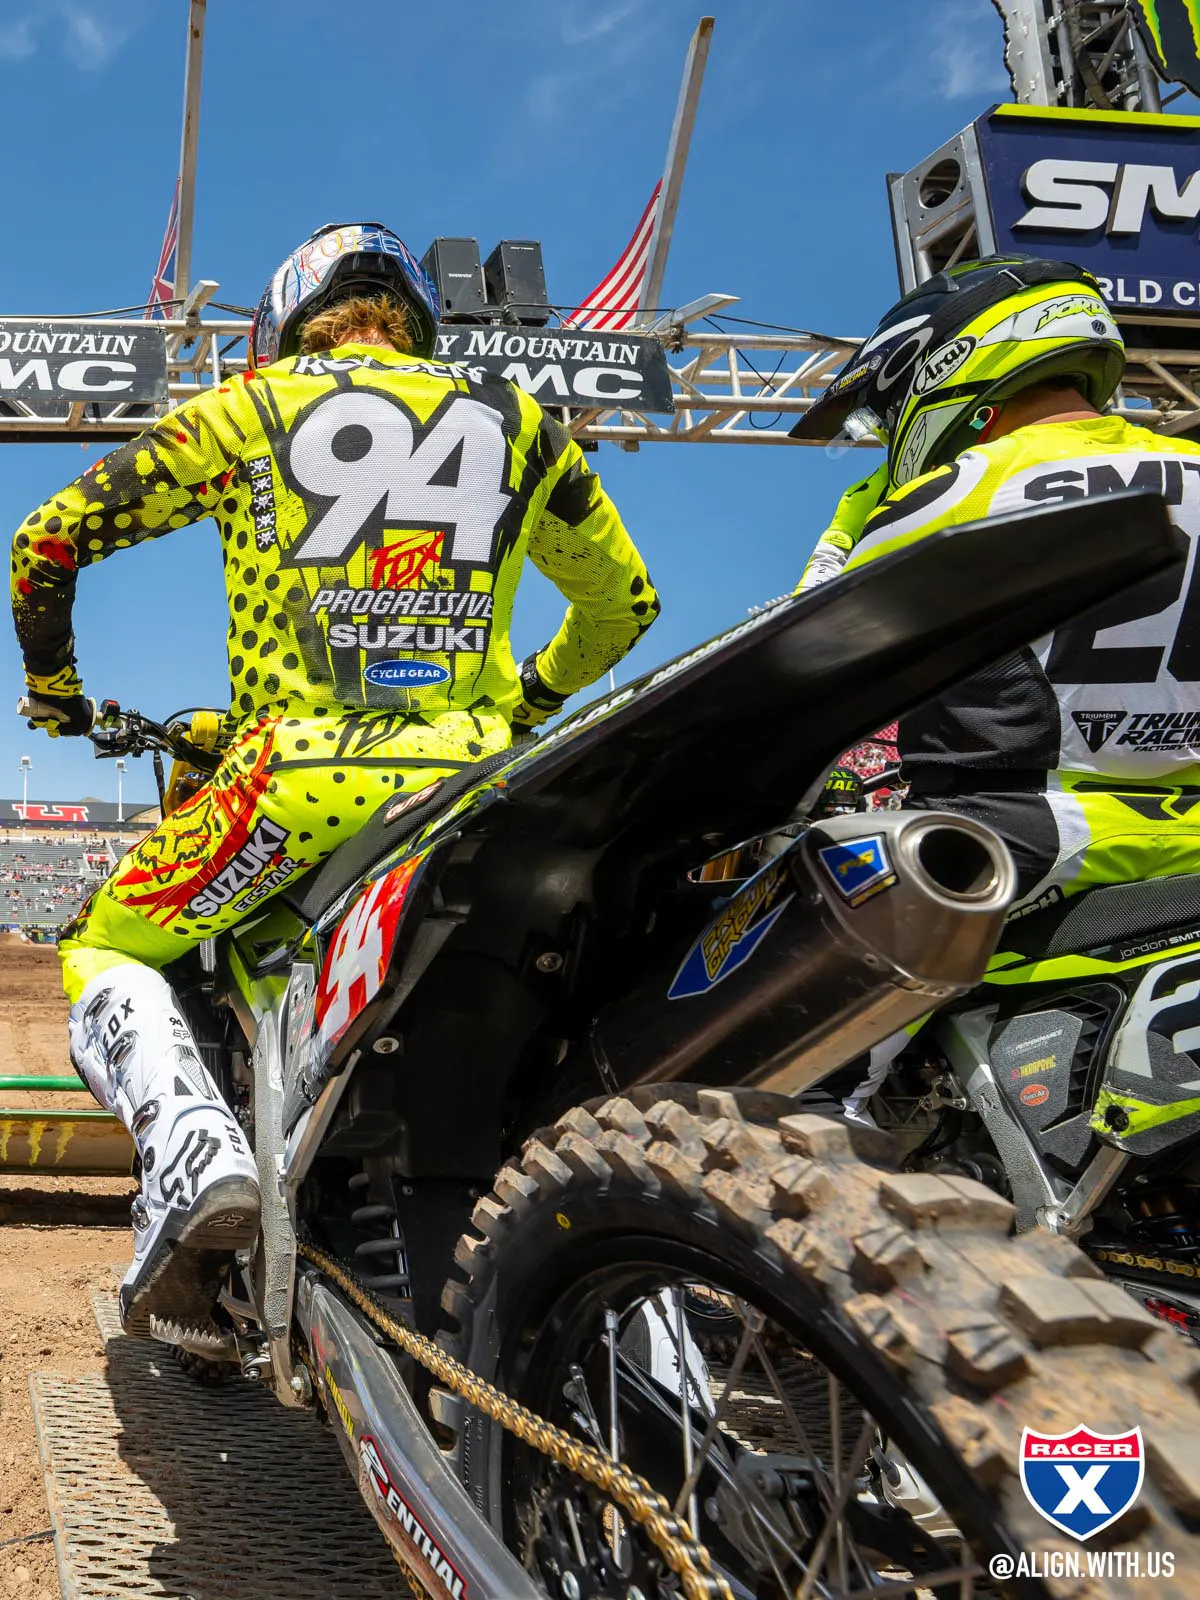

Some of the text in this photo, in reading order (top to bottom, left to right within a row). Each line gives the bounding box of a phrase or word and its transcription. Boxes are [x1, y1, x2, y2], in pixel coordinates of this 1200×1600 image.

[1097, 277, 1163, 304] RLD
[1173, 281, 1200, 306] C
[436, 331, 641, 365] Y MOUNTAIN
[920, 341, 968, 393] Arai
[289, 391, 512, 562] 94
[310, 588, 494, 618] PROGRESSIVE
[1044, 524, 1200, 684] 2
[329, 624, 484, 651] SUZUKI
[371, 669, 441, 679] CYCLE GEAR
[190, 818, 287, 917] SUZUKI
[234, 858, 300, 912] ECSTAR
[1120, 938, 1168, 960] jordon
[102, 997, 135, 1050] FOX
[169, 1016, 185, 1028] 94
[224, 1124, 246, 1155] FOX
